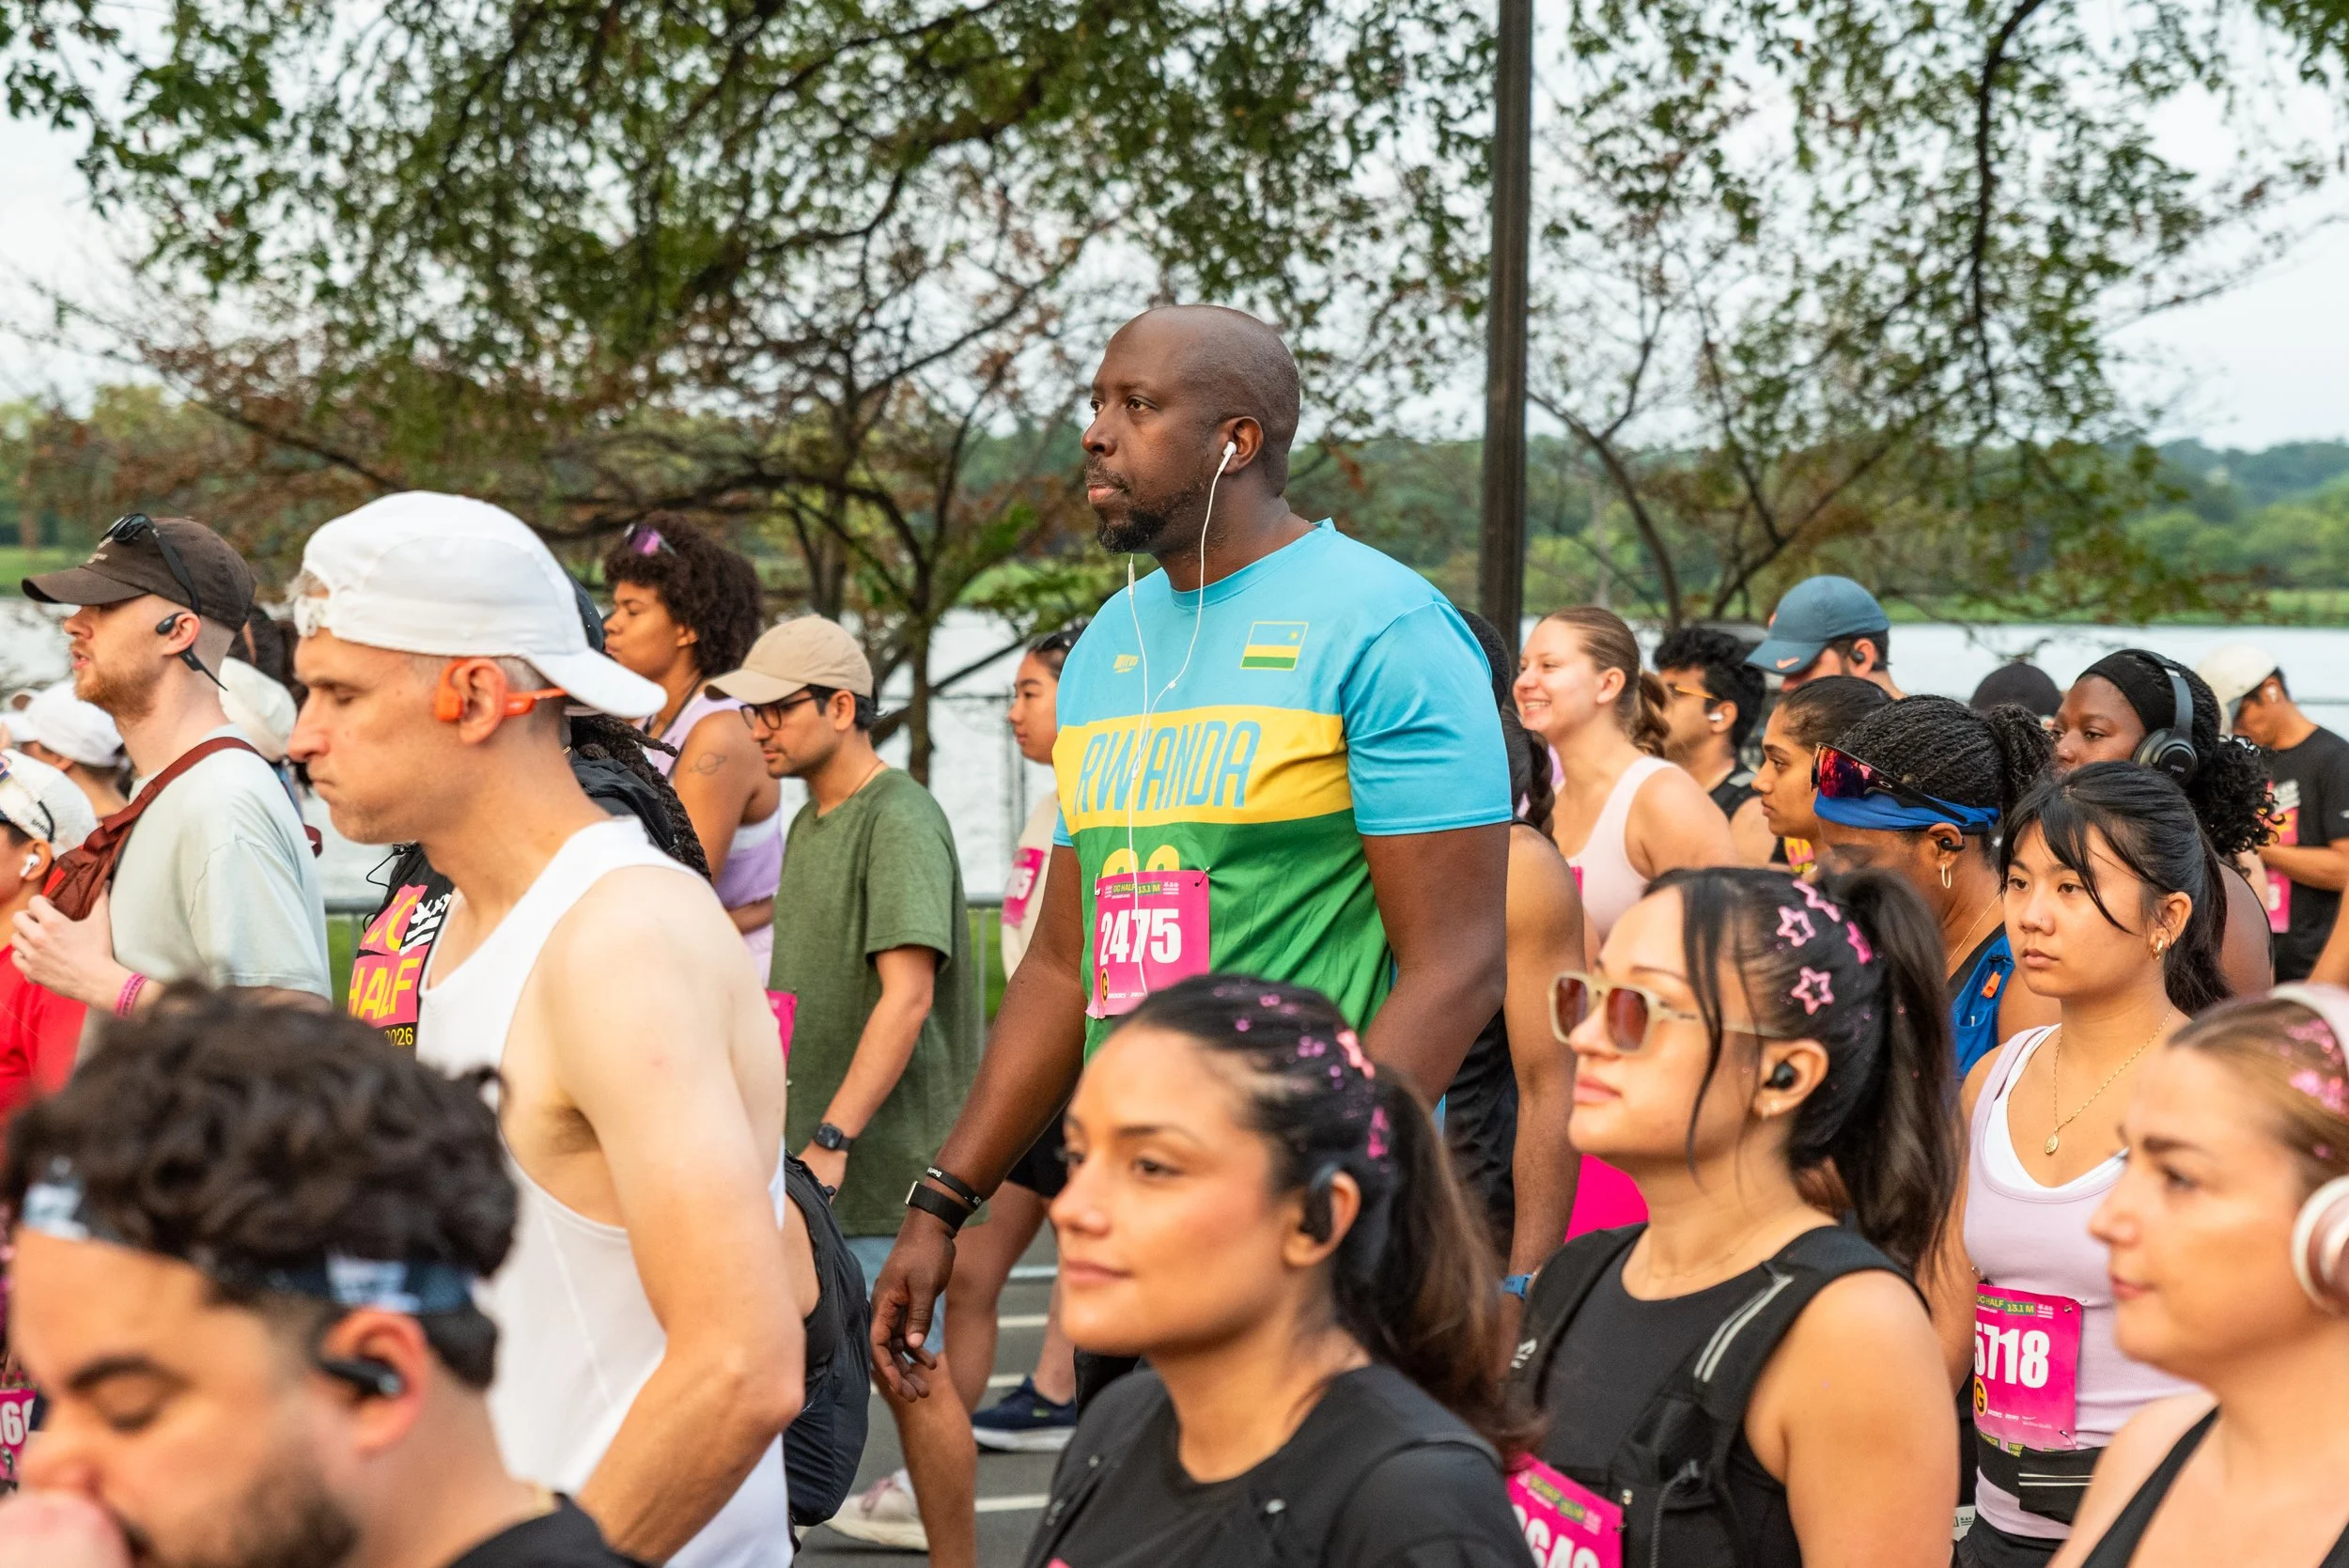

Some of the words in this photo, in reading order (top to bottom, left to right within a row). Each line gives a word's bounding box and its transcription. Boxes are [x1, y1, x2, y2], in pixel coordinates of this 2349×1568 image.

[1075, 721, 1261, 815] RWANDA
[1099, 908, 1181, 967] 2475
[349, 957, 421, 1019] HALF
[1985, 1297, 2004, 1308] HALF
[2007, 1303, 2024, 1312] 13.1
[2025, 1305, 2034, 1313] M
